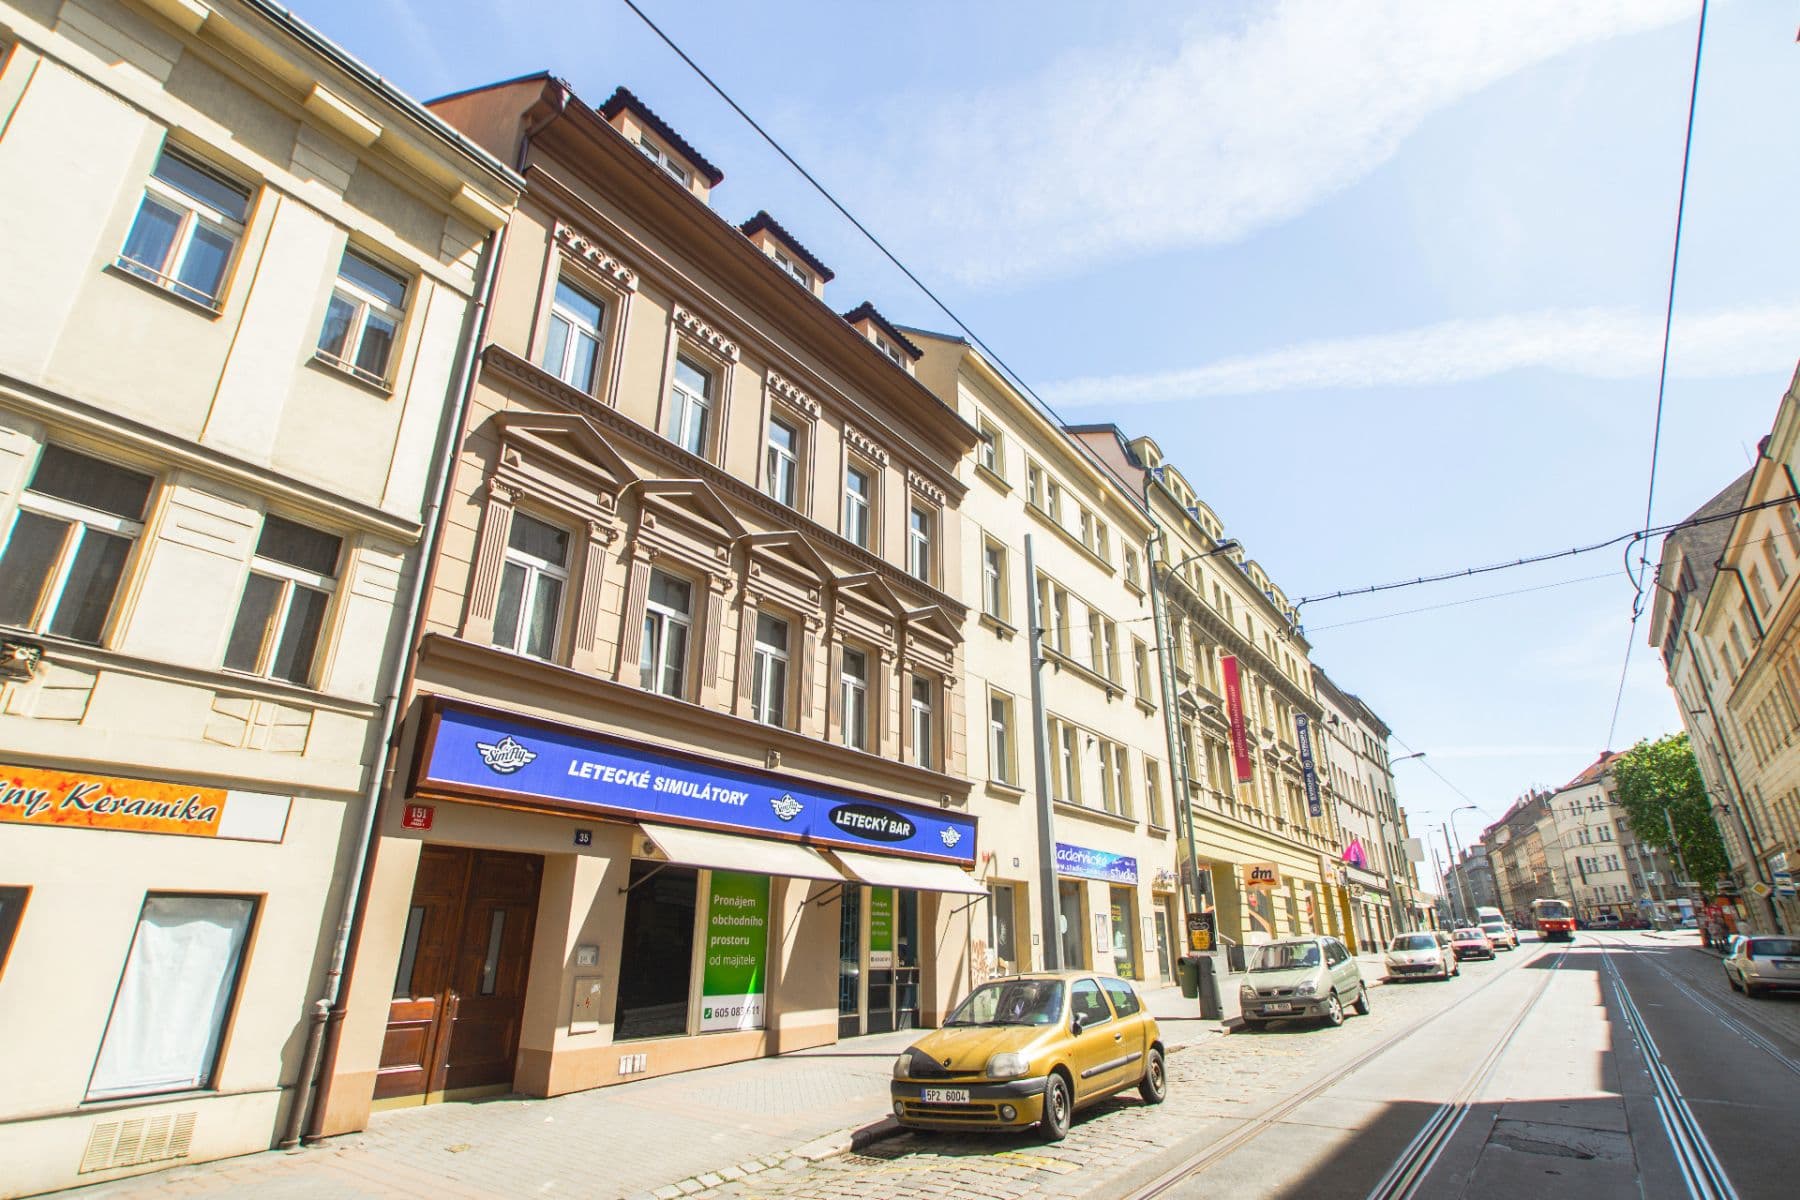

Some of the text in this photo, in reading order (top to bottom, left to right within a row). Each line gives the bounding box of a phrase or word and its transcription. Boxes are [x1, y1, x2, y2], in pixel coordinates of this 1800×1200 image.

[1300, 729, 1310, 757] EVROPA
[567, 760, 750, 806] LETECKÉ SIMULÁTORY
[1306, 772, 1317, 801] EVROPA
[60, 782, 217, 822] Keramika
[412, 807, 427, 818] 151
[835, 810, 911, 836] LETECKÝ BAR
[579, 833, 589, 843] 35
[1251, 867, 1272, 879] dm
[713, 894, 756, 909] Pronájem
[712, 914, 763, 927] obchodního
[711, 935, 750, 948] prostoru
[709, 954, 756, 968] od majitele
[714, 1007, 729, 1018] 605
[926, 1090, 966, 1102] 5P2 6004
